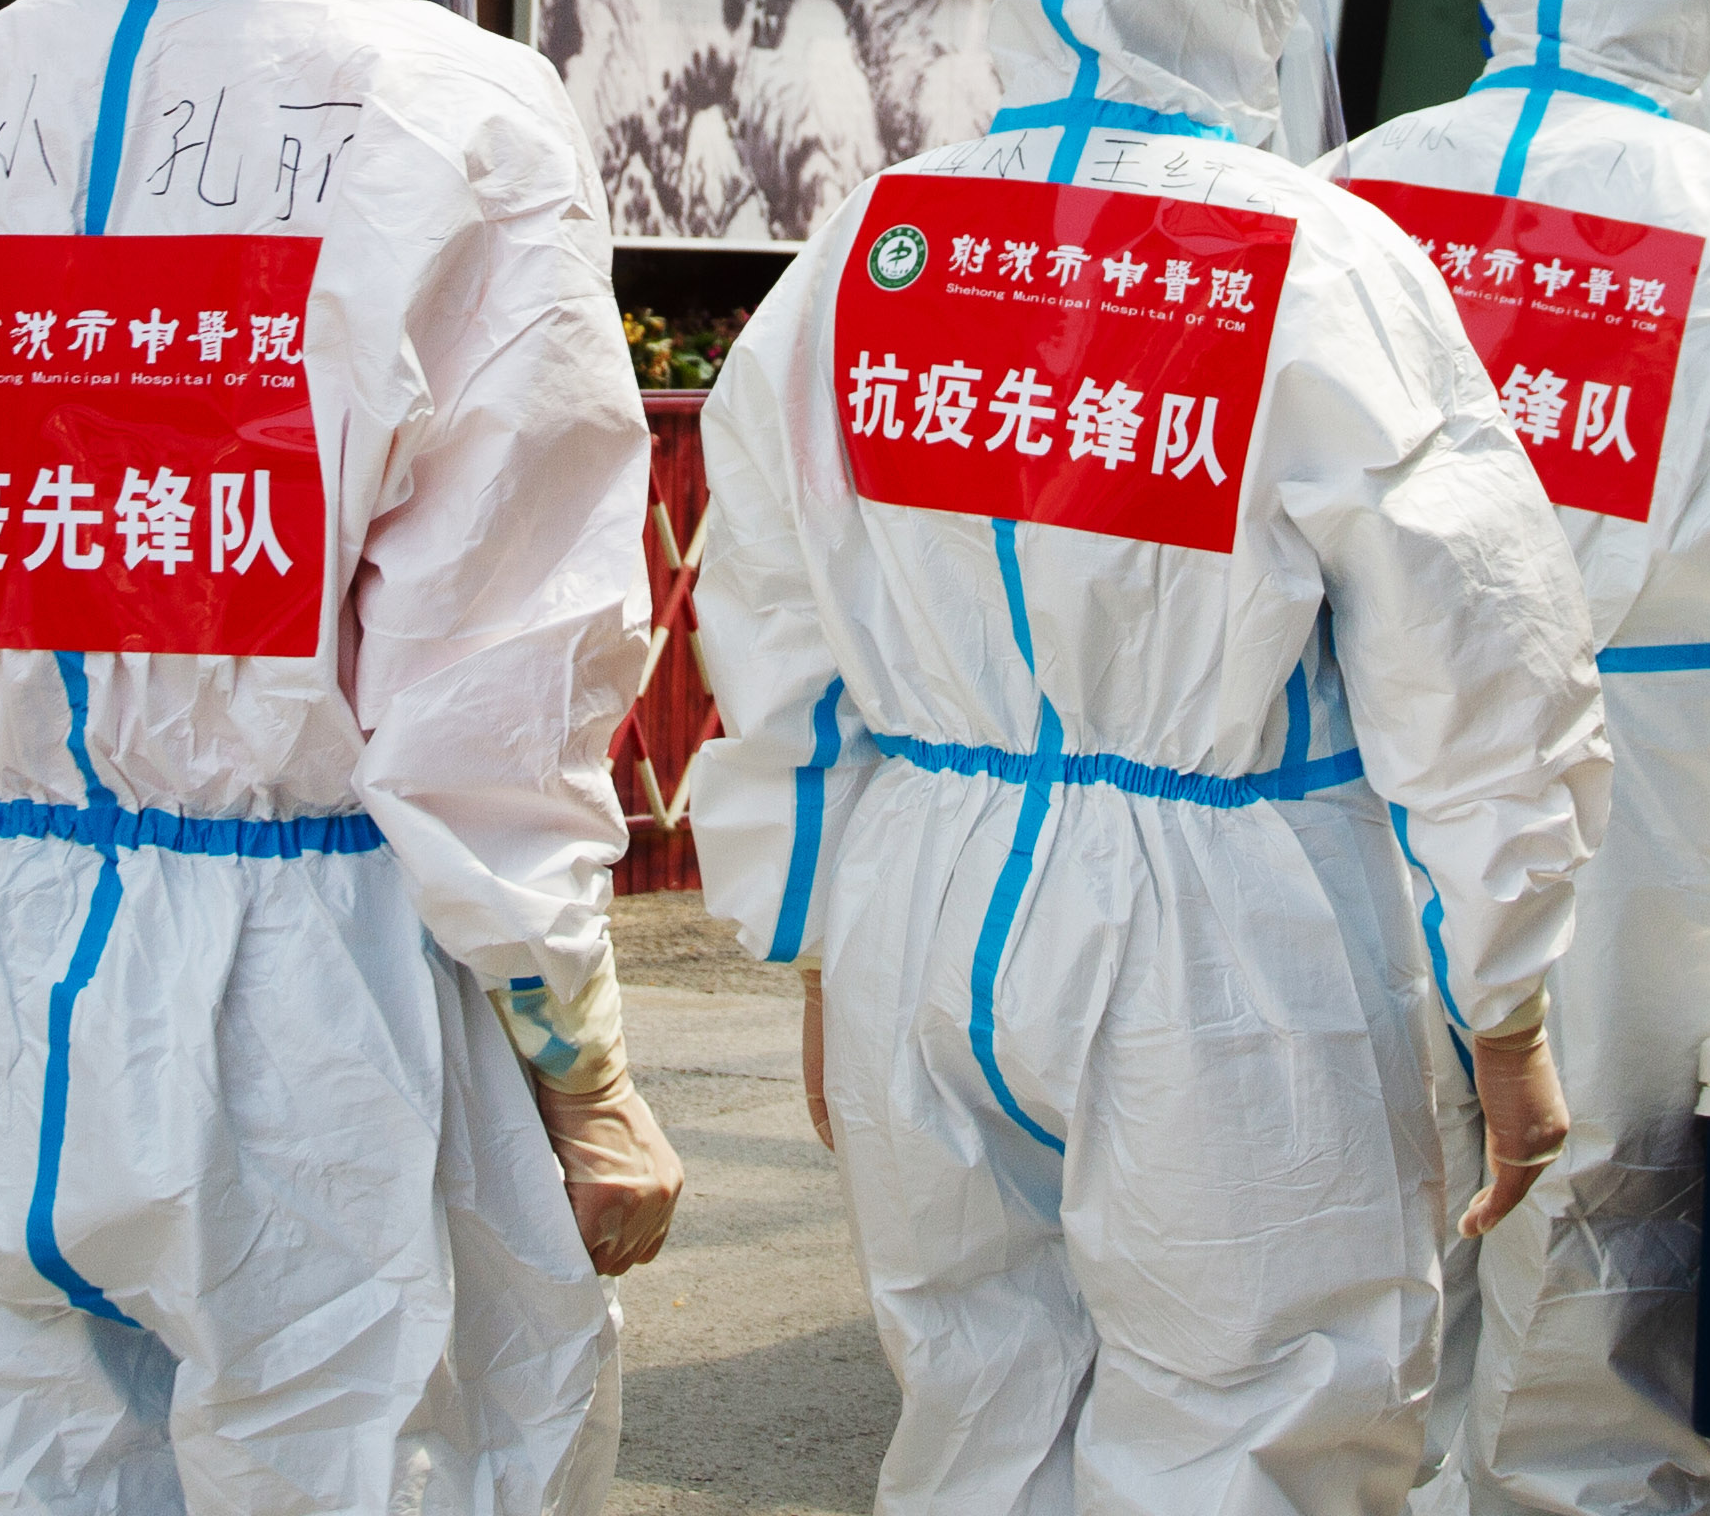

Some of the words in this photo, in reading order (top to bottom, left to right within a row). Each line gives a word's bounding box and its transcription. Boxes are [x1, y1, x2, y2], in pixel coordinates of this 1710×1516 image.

[945, 282, 1006, 302] Shehong
[1012, 288, 1091, 310] Municipal
[1100, 300, 1174, 322] Hospital
[1184, 313, 1205, 327] Of
[1215, 316, 1247, 334] TCM
[1452, 284, 1524, 307] Municipal
[1530, 299, 1597, 322] Hospital
[1604, 313, 1624, 327] Of
[1630, 318, 1658, 334] TCM
[31, 370, 120, 387] Municipal
[131, 371, 212, 388] Hospital
[224, 372, 248, 387] Of
[260, 373, 295, 389] TCM
[847, 350, 1229, 488] 抗疫先锋队
[1499, 363, 1637, 465] 锋队
